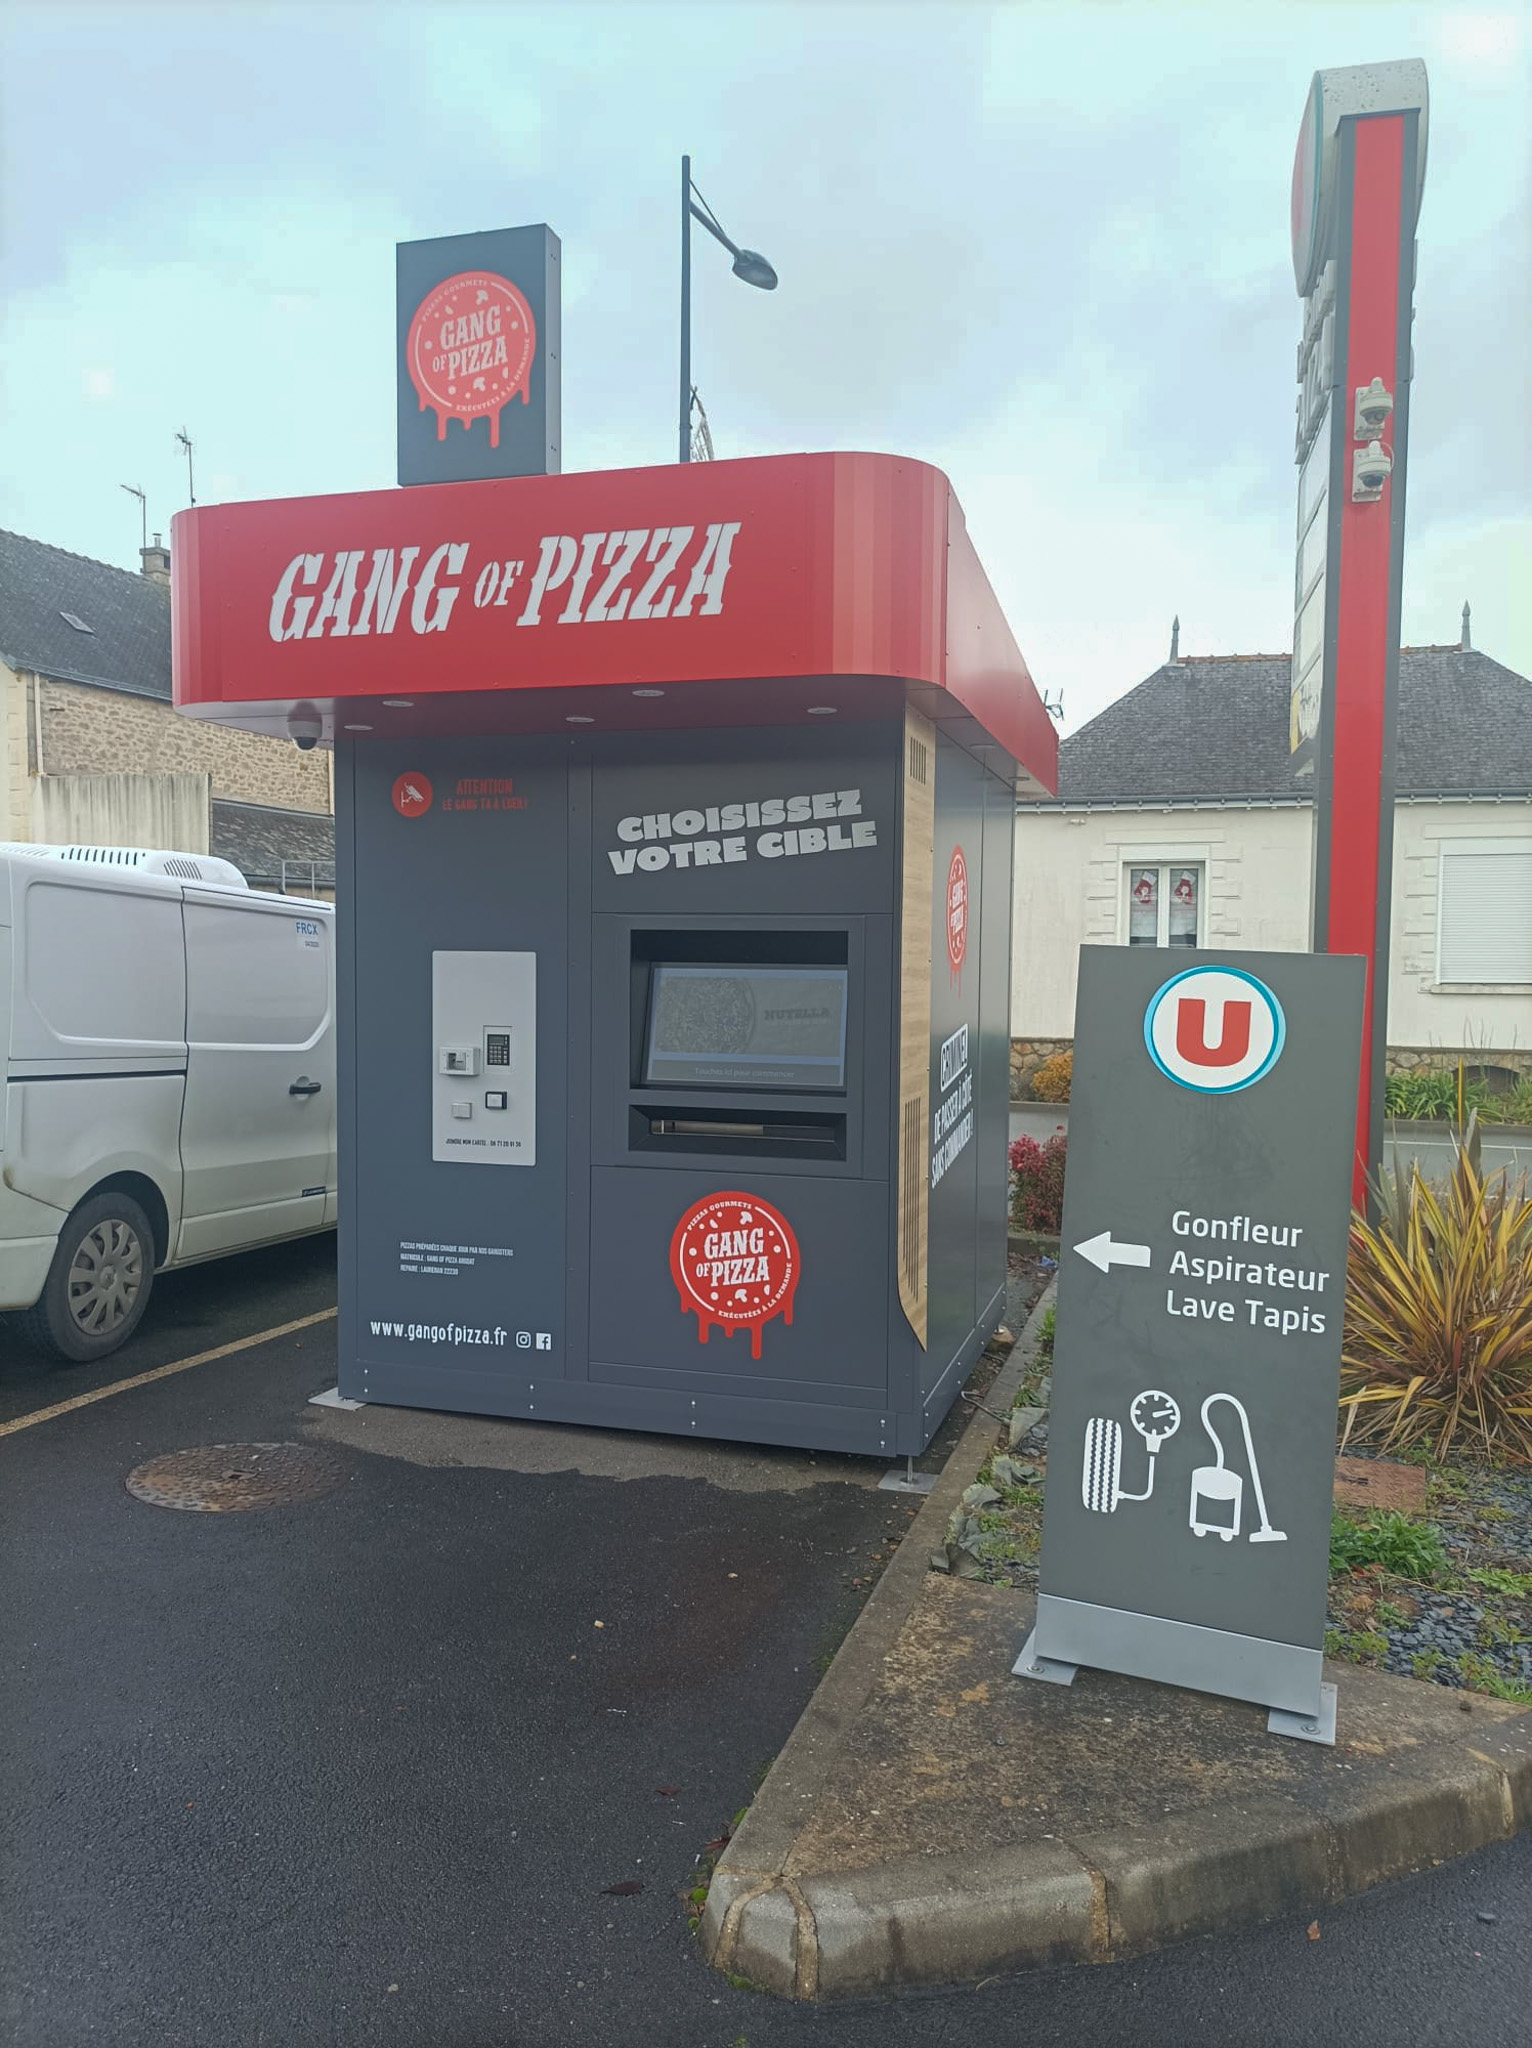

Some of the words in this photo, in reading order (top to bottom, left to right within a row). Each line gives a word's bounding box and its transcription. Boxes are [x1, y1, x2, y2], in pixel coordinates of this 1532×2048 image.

[440, 304, 501, 350] GANG
[432, 355, 447, 373] OF
[448, 335, 509, 380] PIZZA
[269, 542, 470, 642] GANG
[473, 560, 524, 608] OF
[516, 522, 741, 627] PIZZA
[456, 777, 513, 796] ATTENTION
[616, 789, 863, 842] CHOISISSEZ
[608, 836, 748, 875] VOTRE
[756, 820, 878, 858] CIBLE
[296, 921, 319, 936] FRCX
[1176, 998, 1252, 1067] U
[934, 1108, 941, 1144] DE
[932, 1145, 944, 1189] SANS
[686, 1207, 708, 1231] PIZZAS
[708, 1200, 752, 1211] GOURMETS
[1171, 1210, 1304, 1248] Gonfleur
[704, 1228, 765, 1259] GANG
[696, 1261, 711, 1278] OF
[711, 1256, 770, 1287] PIZZA
[768, 1298, 777, 1309] LA
[776, 1262, 793, 1301] DEMANDE
[1169, 1250, 1331, 1292] Aspirateur
[370, 1320, 508, 1346] www.gangofpizza.fr
[1166, 1289, 1236, 1322] Lave
[1244, 1298, 1326, 1335] Tapis
